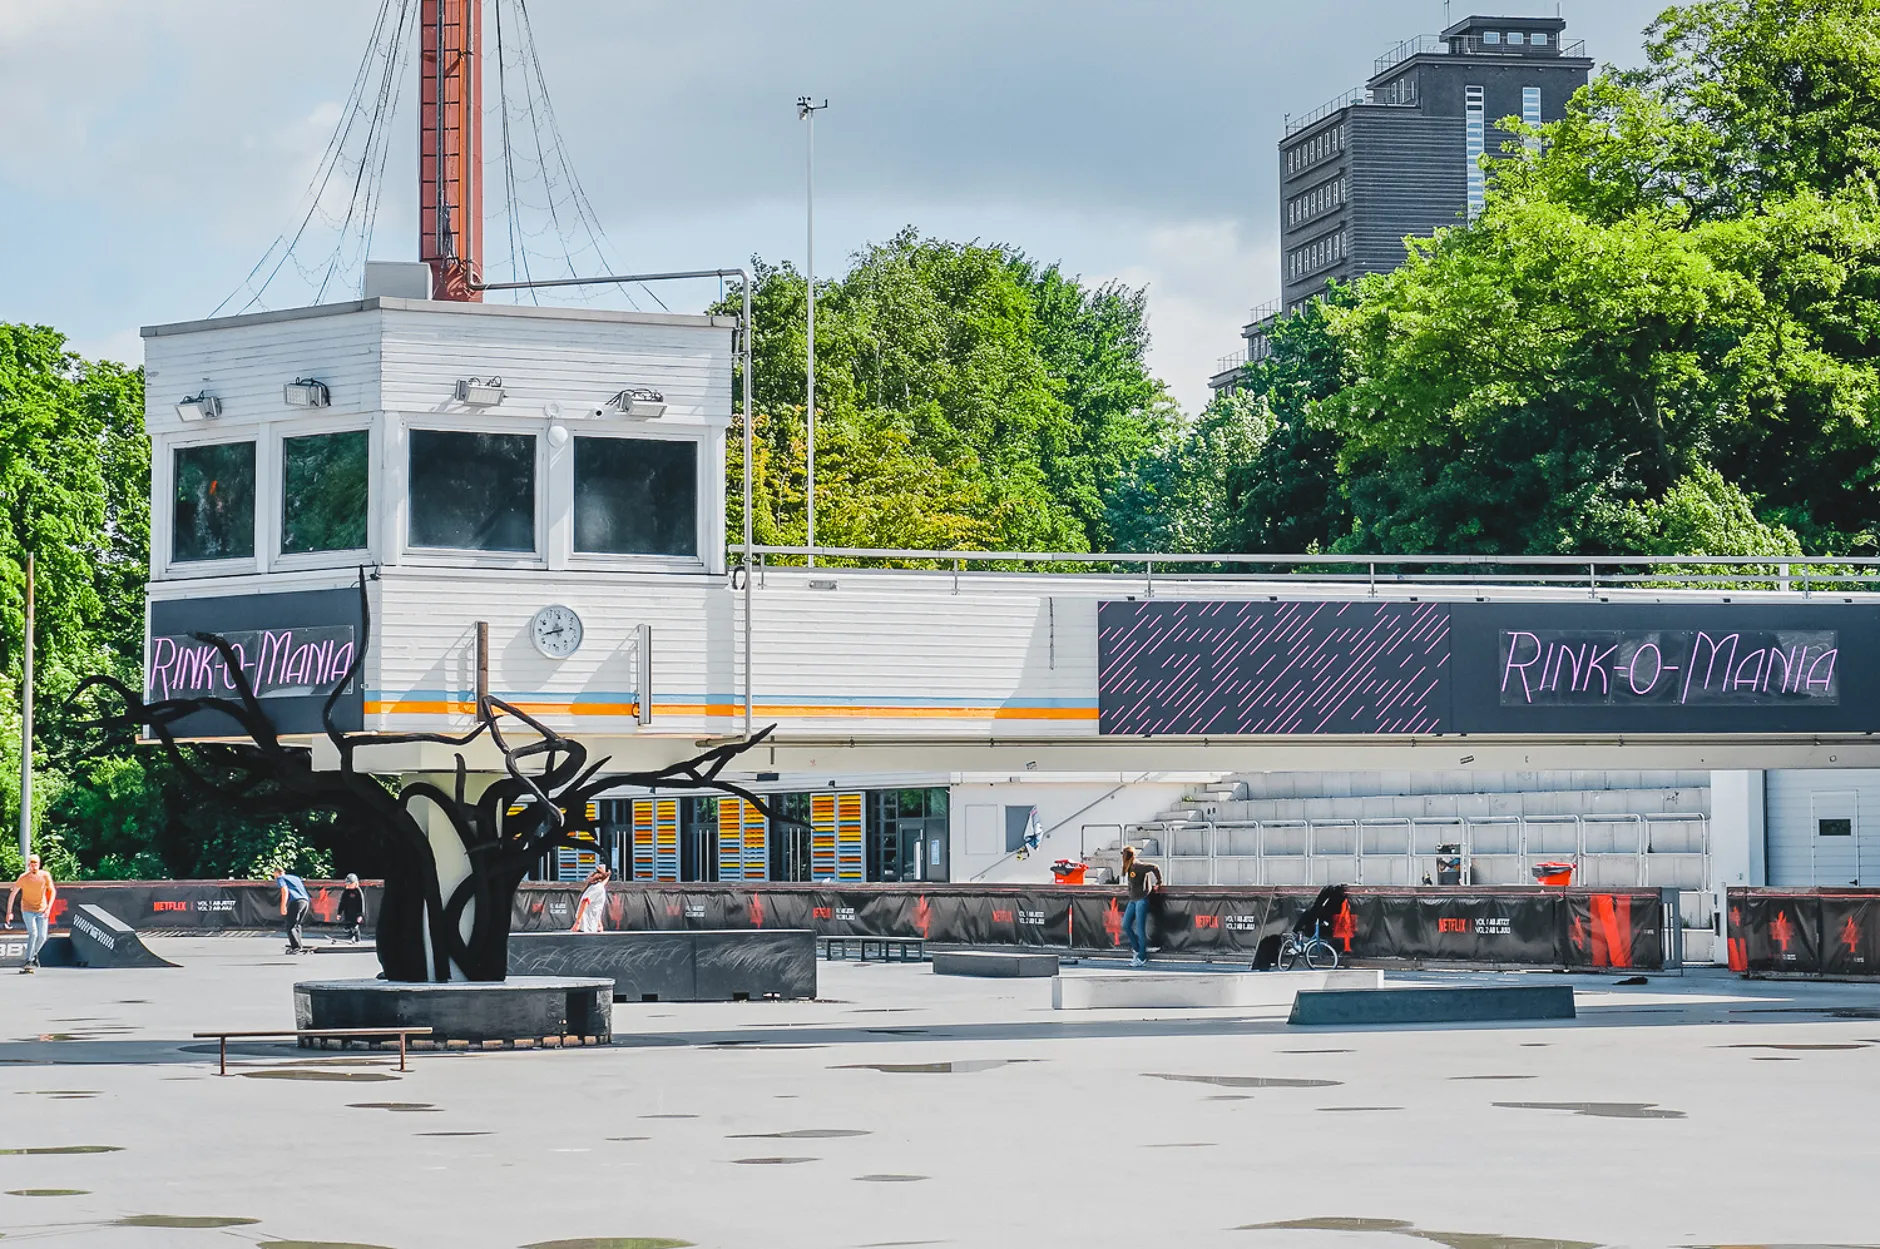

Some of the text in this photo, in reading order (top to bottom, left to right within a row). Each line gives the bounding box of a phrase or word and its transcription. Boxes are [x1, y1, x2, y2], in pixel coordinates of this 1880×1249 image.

[1501, 630, 1839, 705] RINK-O-MANIA
[153, 901, 187, 912] NETFLIX
[1195, 915, 1219, 929] NETFLIX
[1438, 918, 1466, 933] NETFLIX
